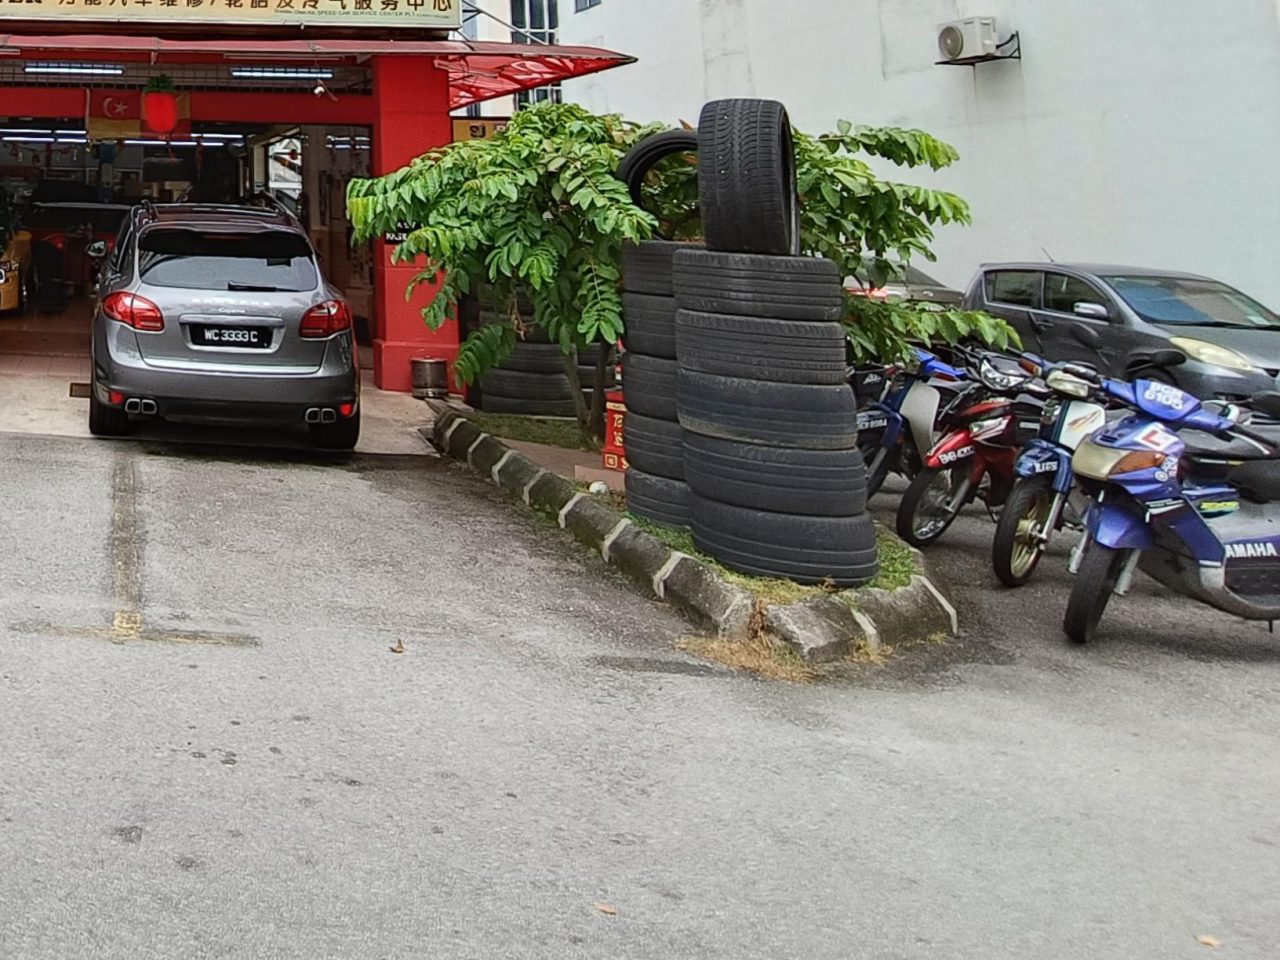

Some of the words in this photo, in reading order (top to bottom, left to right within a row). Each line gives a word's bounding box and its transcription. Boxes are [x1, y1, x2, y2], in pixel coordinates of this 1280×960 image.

[204, 328, 220, 341] WC
[220, 329, 249, 342] 3333
[250, 330, 258, 342] C
[1226, 542, 1278, 558] AMAHA
